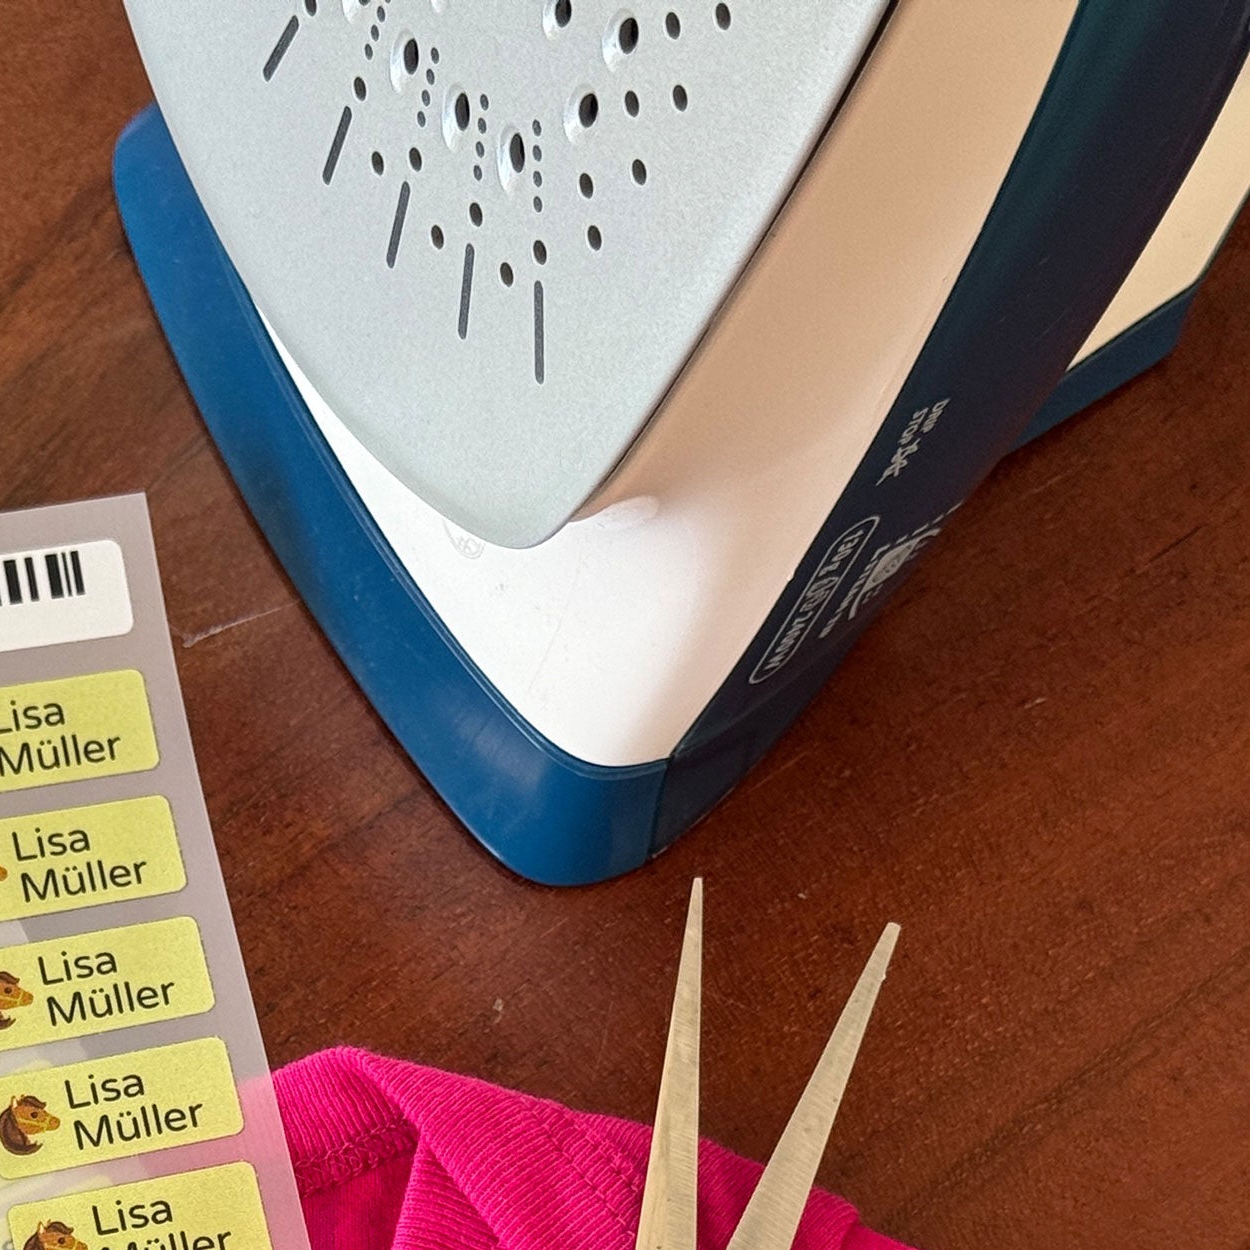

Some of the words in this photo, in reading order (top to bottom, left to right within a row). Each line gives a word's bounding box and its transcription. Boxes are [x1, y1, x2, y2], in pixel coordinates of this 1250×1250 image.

[11, 827, 91, 862] Lisa
[20, 859, 147, 903] Müller
[37, 950, 118, 986] Lisa
[46, 981, 175, 1027] Müller
[64, 1073, 145, 1110] Lisa
[73, 1103, 203, 1151] Müller
[91, 1199, 173, 1236] Lisa
